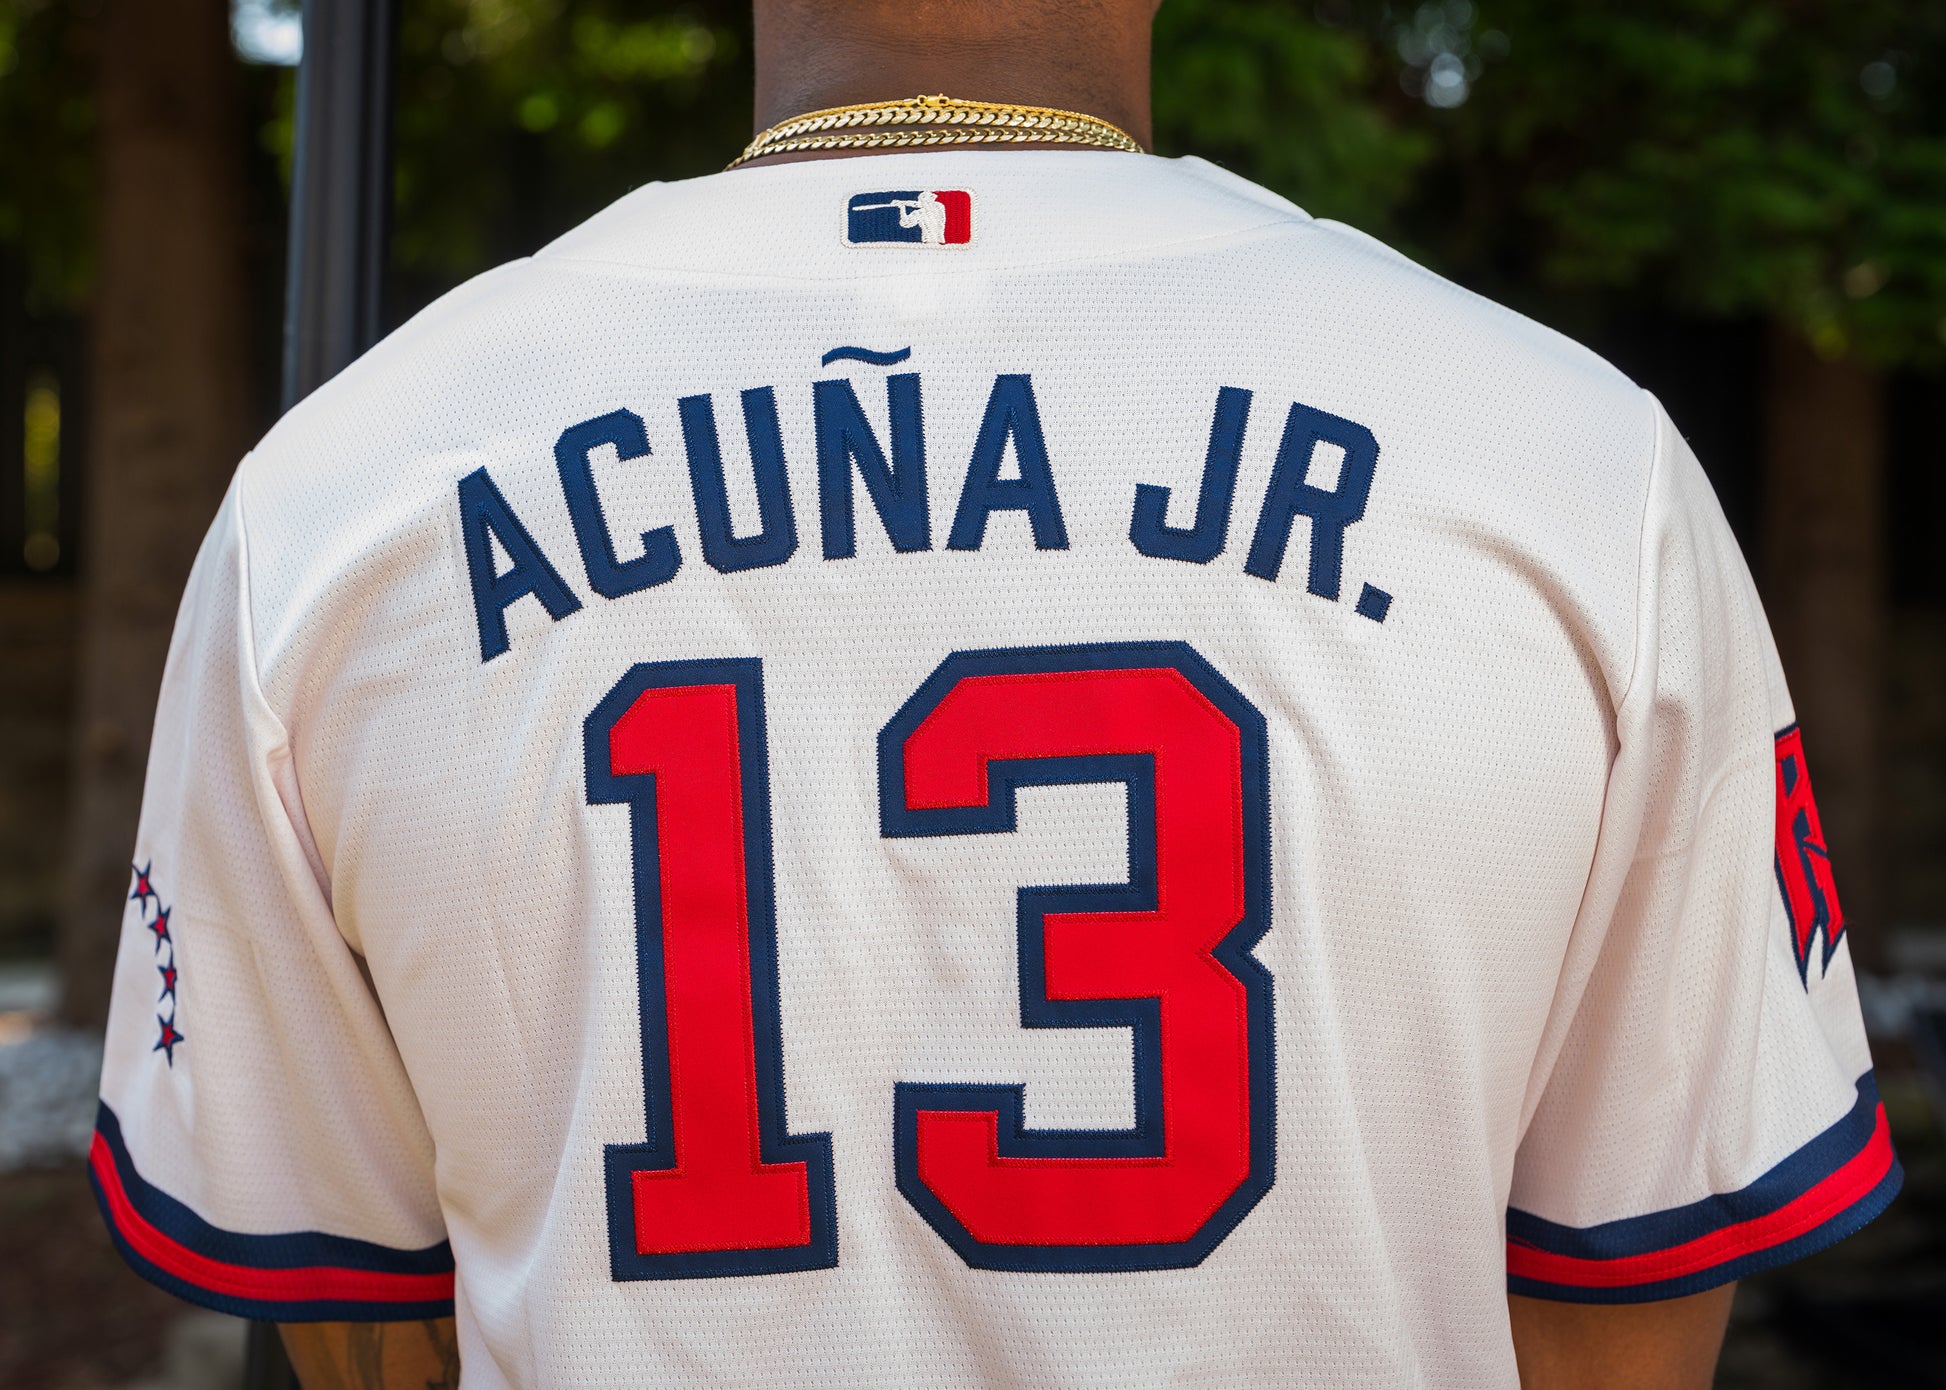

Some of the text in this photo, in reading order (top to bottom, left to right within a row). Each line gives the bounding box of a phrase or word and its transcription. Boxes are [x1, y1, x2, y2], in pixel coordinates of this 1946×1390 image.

[457, 346, 1393, 662] ACUÑA JR.
[583, 640, 1277, 1282] 13
